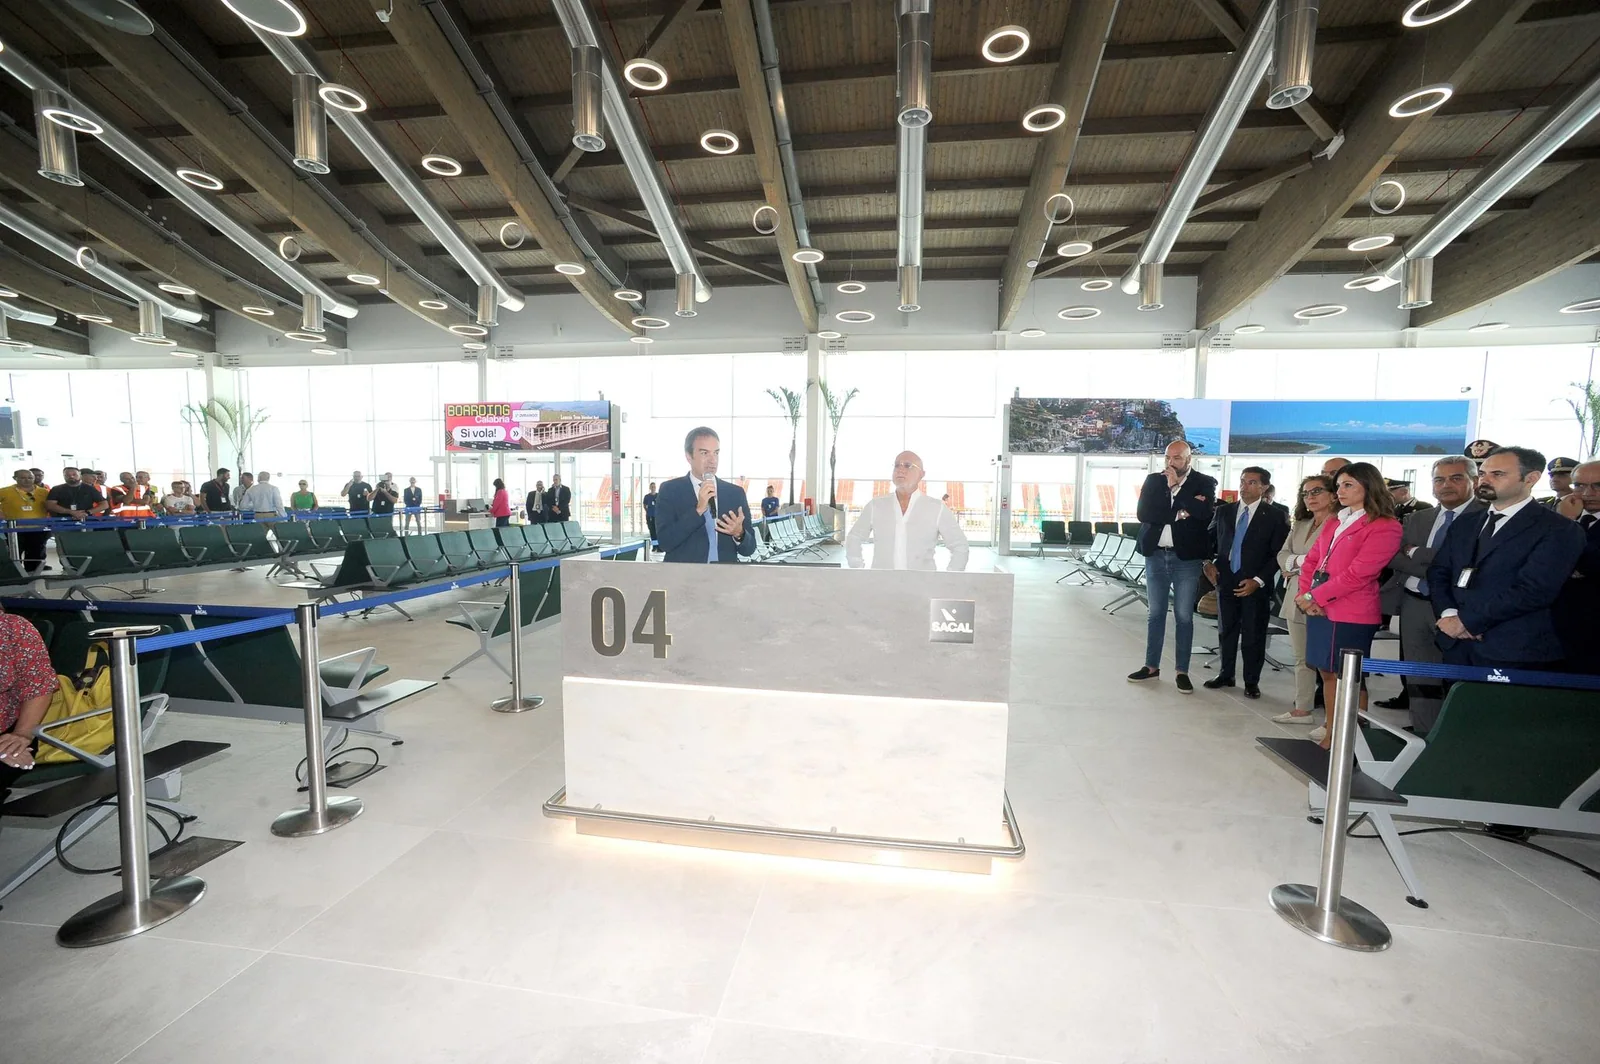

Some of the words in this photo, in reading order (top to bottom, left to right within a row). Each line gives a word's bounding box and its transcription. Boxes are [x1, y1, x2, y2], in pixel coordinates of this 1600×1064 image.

[475, 414, 510, 423] Calabria
[460, 428, 470, 438] Si
[472, 427, 497, 438] vola!
[591, 586, 673, 659] 04
[931, 621, 973, 634] SACAL
[1487, 674, 1511, 683] SACAL
